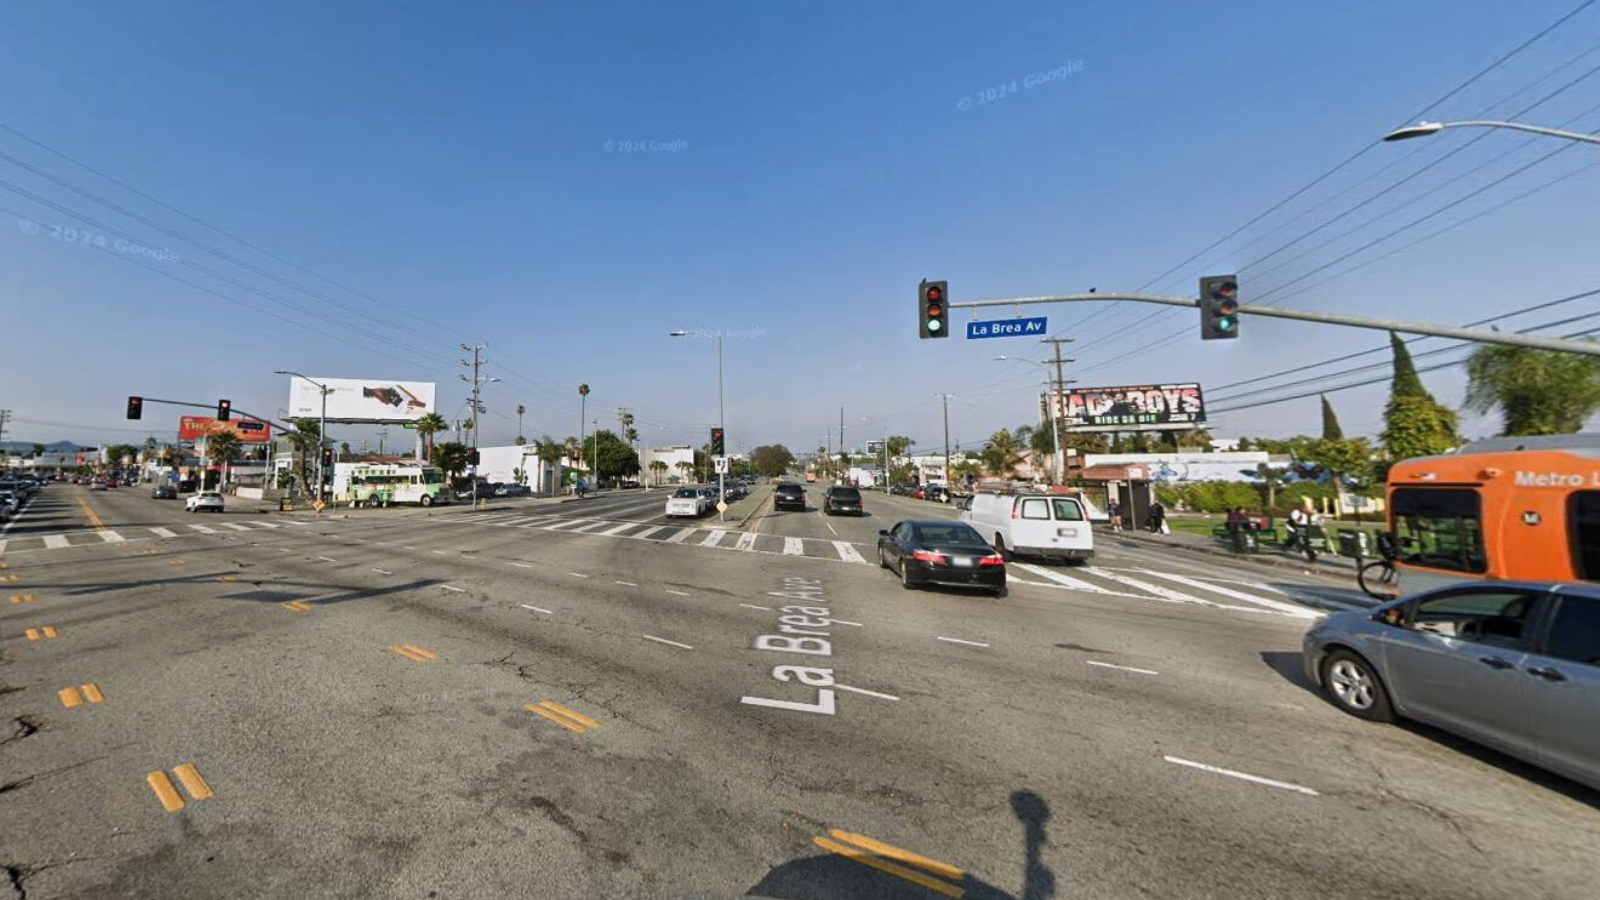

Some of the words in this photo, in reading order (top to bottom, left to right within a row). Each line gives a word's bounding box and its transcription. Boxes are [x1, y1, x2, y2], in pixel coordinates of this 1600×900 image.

[972, 325, 987, 335] La
[992, 323, 1021, 334] Brea
[1025, 321, 1042, 331] Av
[1095, 415, 1119, 425] RIDE
[1514, 470, 1584, 487] Metro
